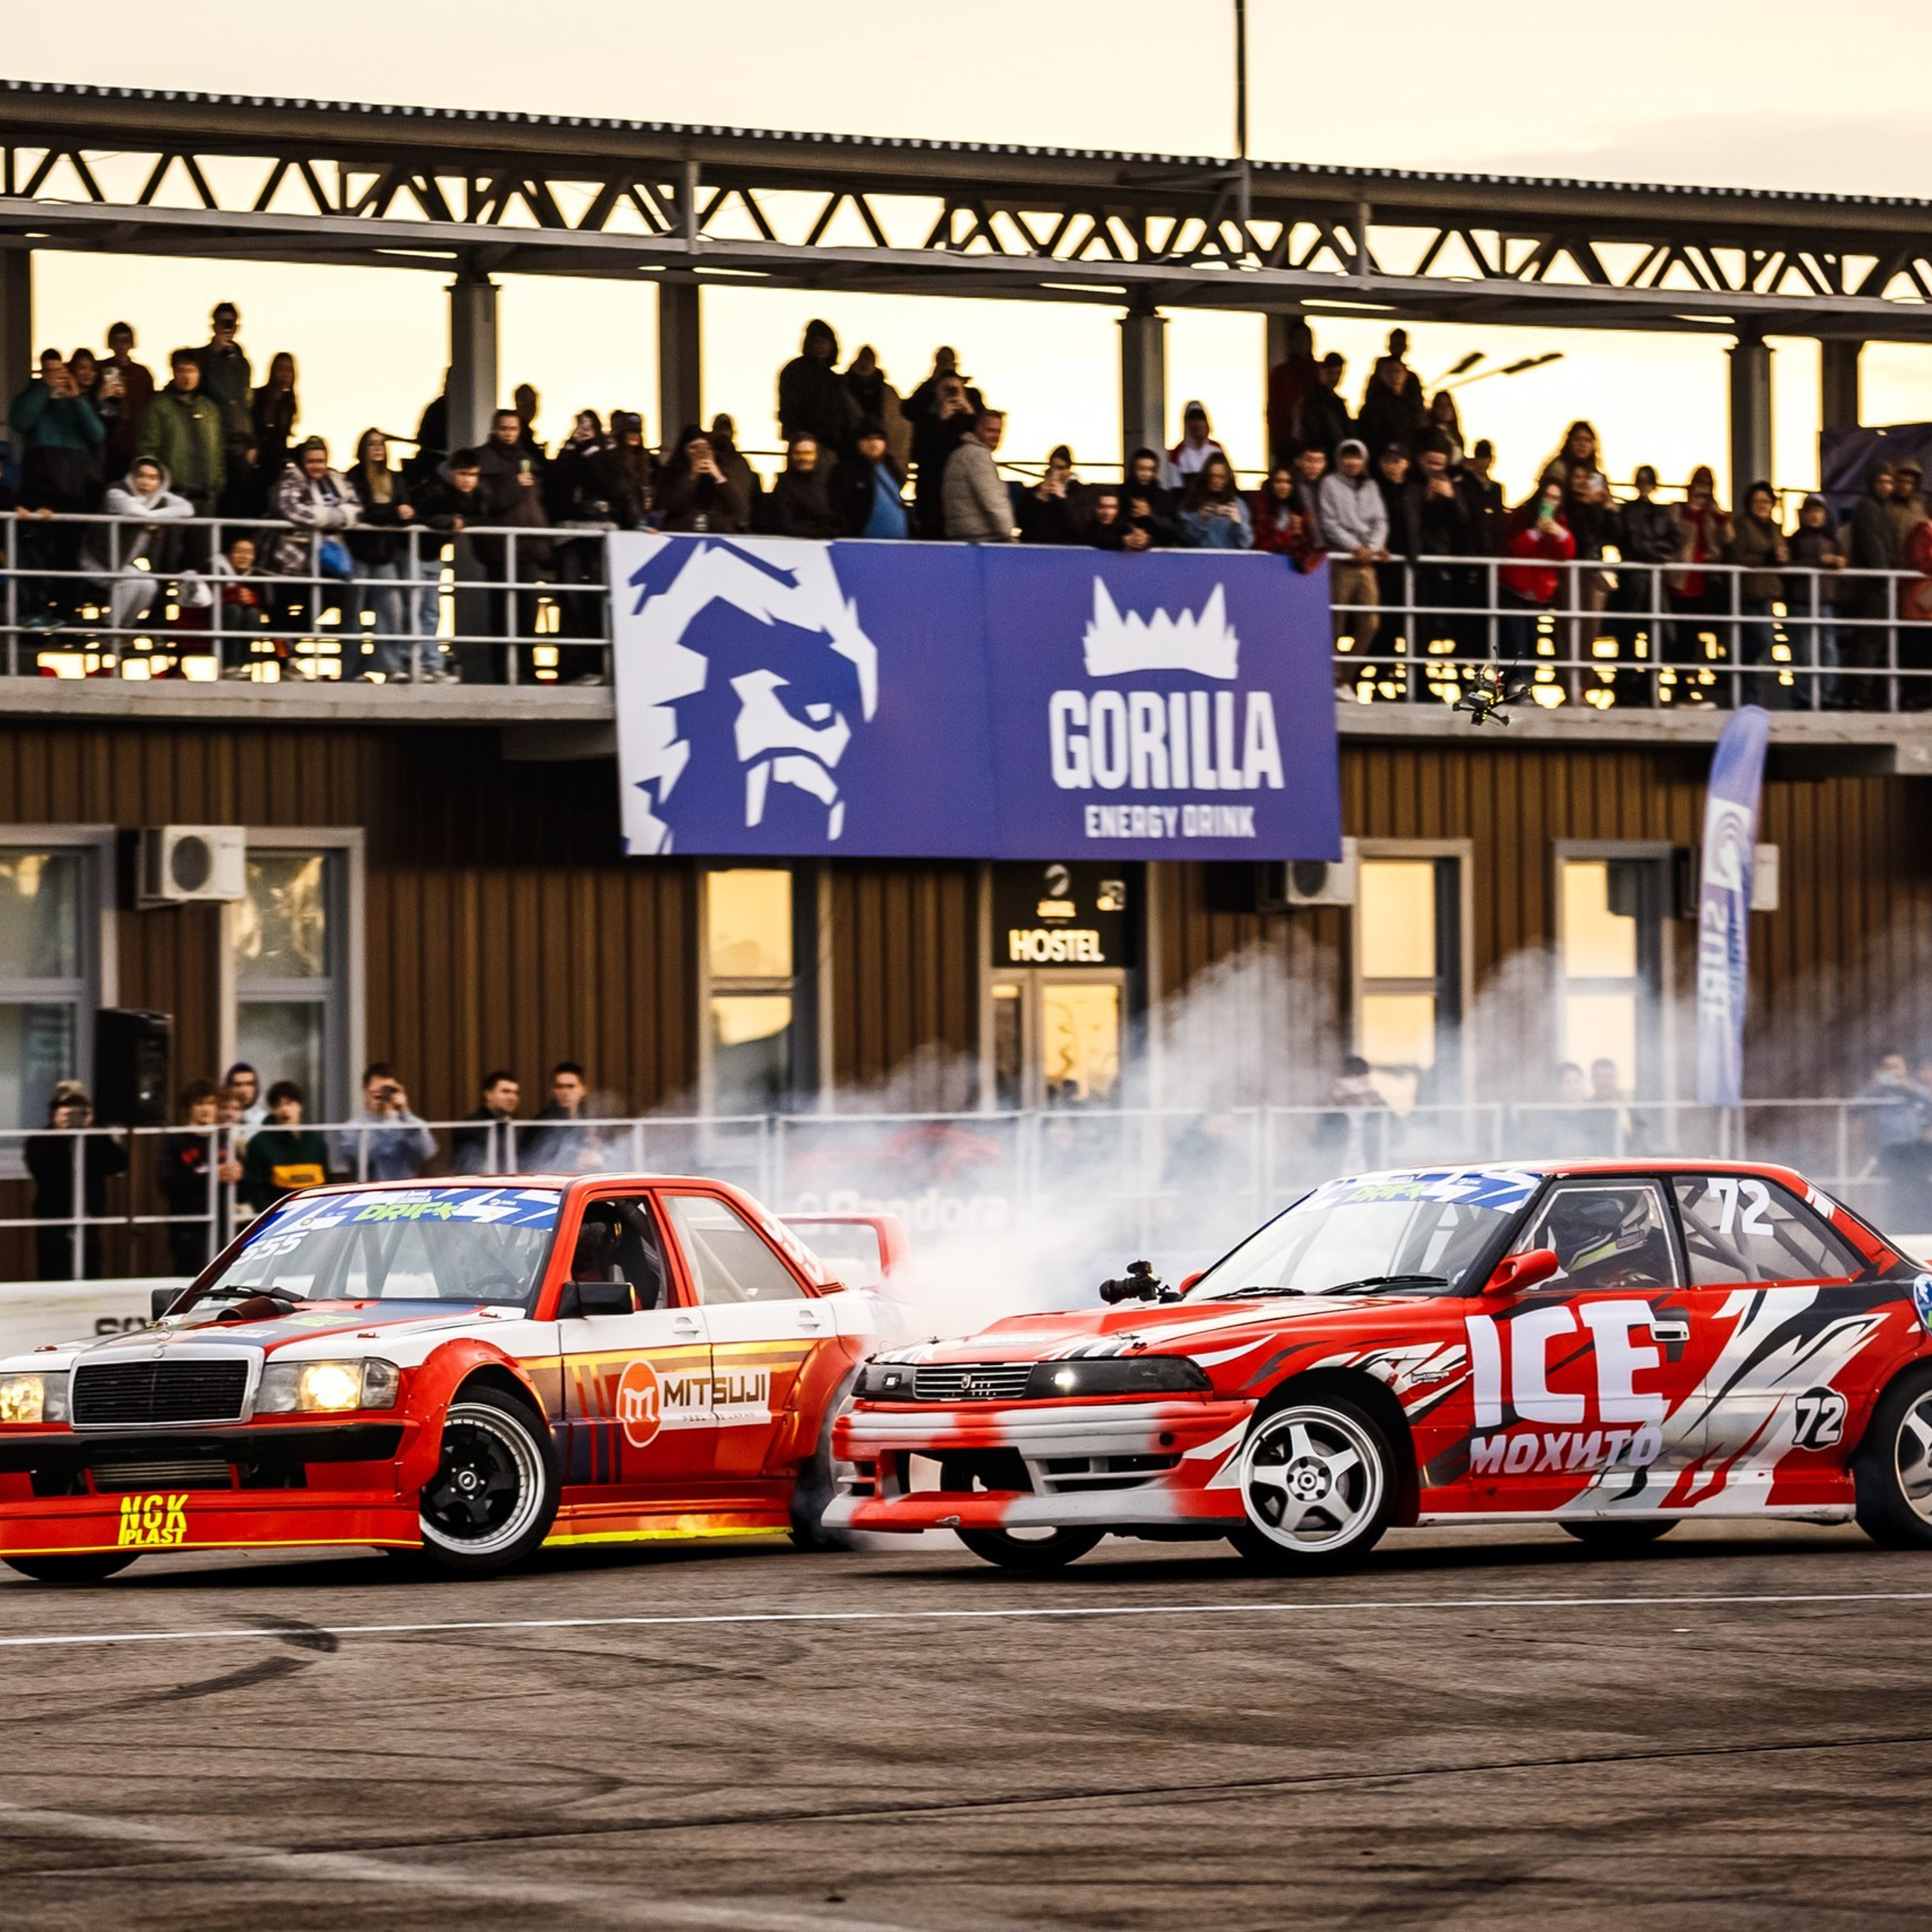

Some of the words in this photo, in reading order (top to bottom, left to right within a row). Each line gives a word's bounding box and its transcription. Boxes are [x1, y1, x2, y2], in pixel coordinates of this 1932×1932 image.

[1050, 690, 1285, 790] GORILLA
[1085, 804, 1178, 838] ENERGY
[1183, 804, 1257, 838] DRINK
[1009, 928, 1105, 962] HOSTEL
[352, 1201, 459, 1222] DRIFT
[1707, 1177, 1774, 1236] 72
[231, 1231, 310, 1266] 555
[1464, 1300, 1663, 1429] ICE
[664, 1374, 765, 1407] MITSUJI
[1793, 1397, 1844, 1443] 72
[1469, 1426, 1663, 1474] МОХИТО
[125, 1527, 187, 1544] PLAST
